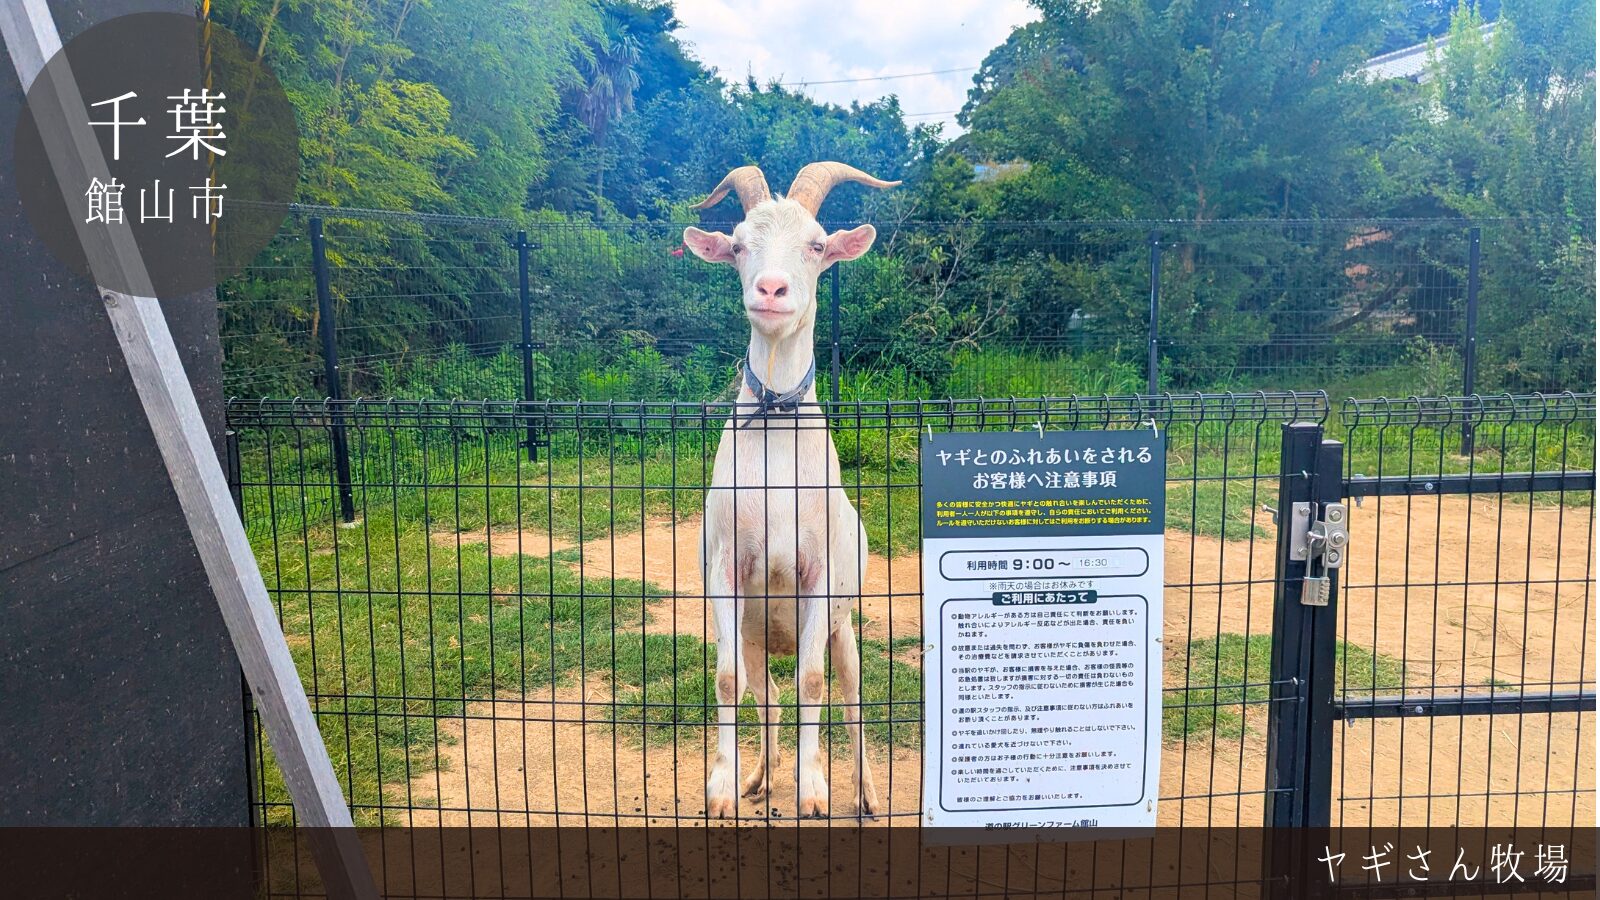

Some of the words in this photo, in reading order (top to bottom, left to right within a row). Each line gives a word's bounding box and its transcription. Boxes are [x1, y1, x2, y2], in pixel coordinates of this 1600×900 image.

[936, 447, 1152, 466] ヤギとのふれあいをされる
[973, 470, 1117, 489] お客様へ注意事項
[967, 559, 1008, 571] 利用時間
[1079, 558, 1108, 567] 16:30
[1001, 592, 1088, 604] ご利用にあたって
[958, 693, 1014, 701] 同様といたします。
[957, 776, 1019, 784] いただいております。
[985, 819, 1098, 831] 道の駅グリーンファーム館山
